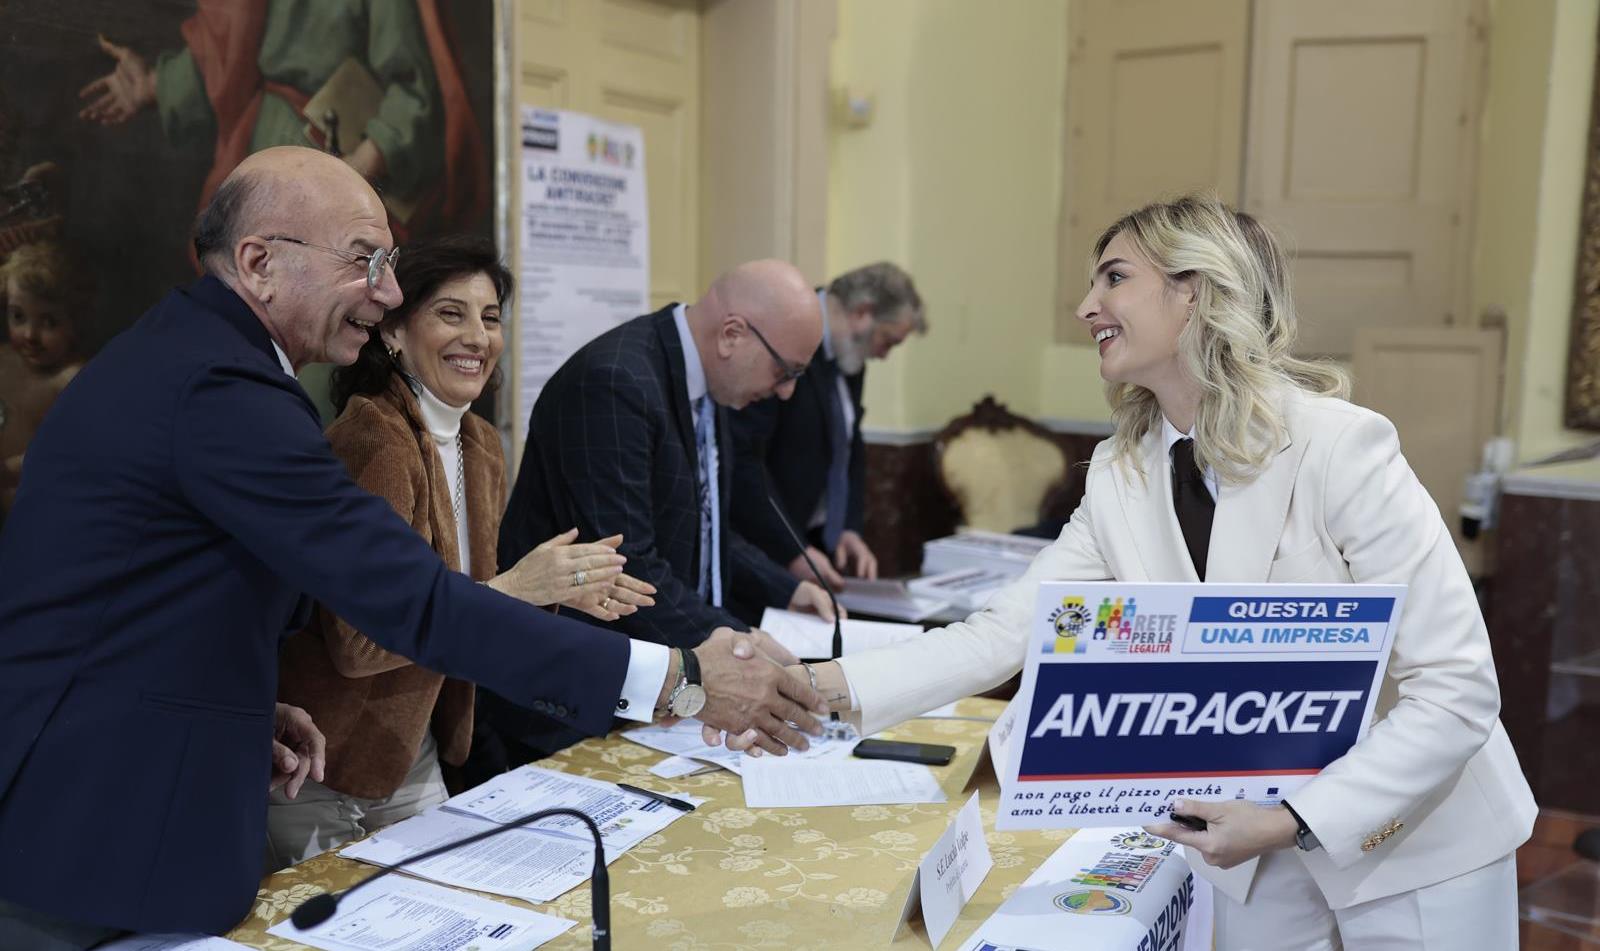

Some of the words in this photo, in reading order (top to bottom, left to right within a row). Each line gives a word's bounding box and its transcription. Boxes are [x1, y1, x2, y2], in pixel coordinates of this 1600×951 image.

[1228, 602, 1329, 619] QUESTA
[1134, 614, 1177, 632] RETE
[1131, 632, 1157, 643] PER
[1160, 632, 1173, 643] LA
[1201, 628, 1254, 644] UNA
[1262, 628, 1370, 643] IMPRESA
[1129, 642, 1171, 653] LEGALITÀ
[1031, 690, 1363, 738] ANTIRACKET
[1014, 790, 1044, 800] non
[1049, 789, 1091, 804] pago
[1099, 787, 1112, 799] il
[1116, 787, 1161, 802] pizzo
[1164, 785, 1222, 801] perchè
[1011, 807, 1042, 816] amo
[1049, 803, 1062, 815] la
[1068, 802, 1119, 815] libertà
[1126, 806, 1133, 814] e
[1138, 801, 1152, 813] la
